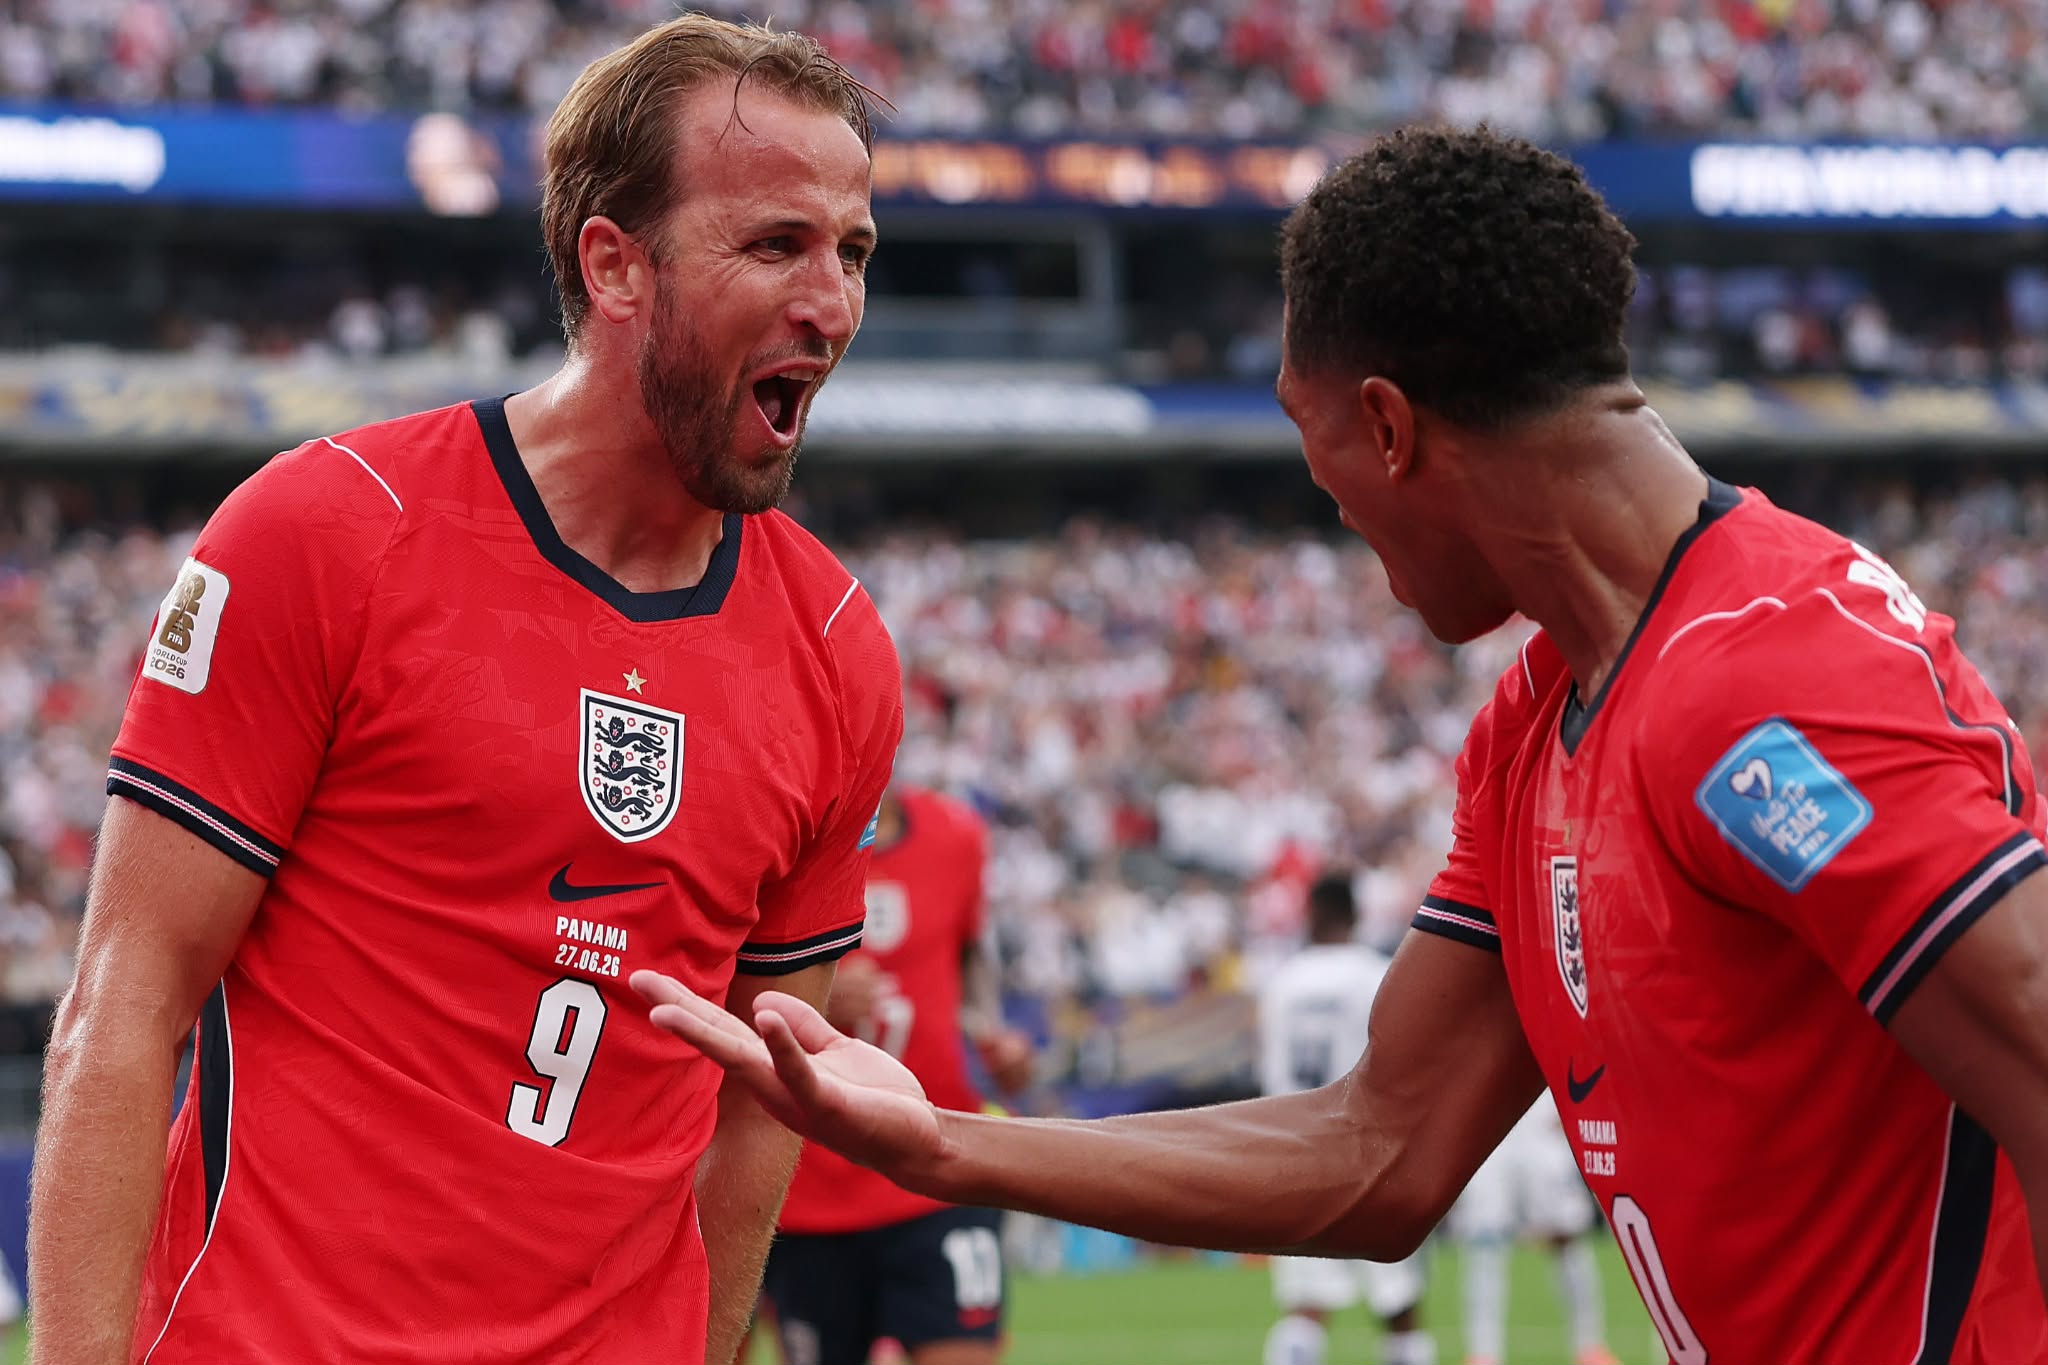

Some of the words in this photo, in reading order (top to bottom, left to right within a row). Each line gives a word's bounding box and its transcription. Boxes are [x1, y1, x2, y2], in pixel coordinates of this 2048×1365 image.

[167, 632, 183, 647] FIFA
[150, 656, 186, 680] 2026
[1769, 798, 1829, 856] PEACE
[555, 915, 628, 951] PANAMA
[554, 943, 621, 978] 27.06.26
[505, 975, 608, 1148] 9
